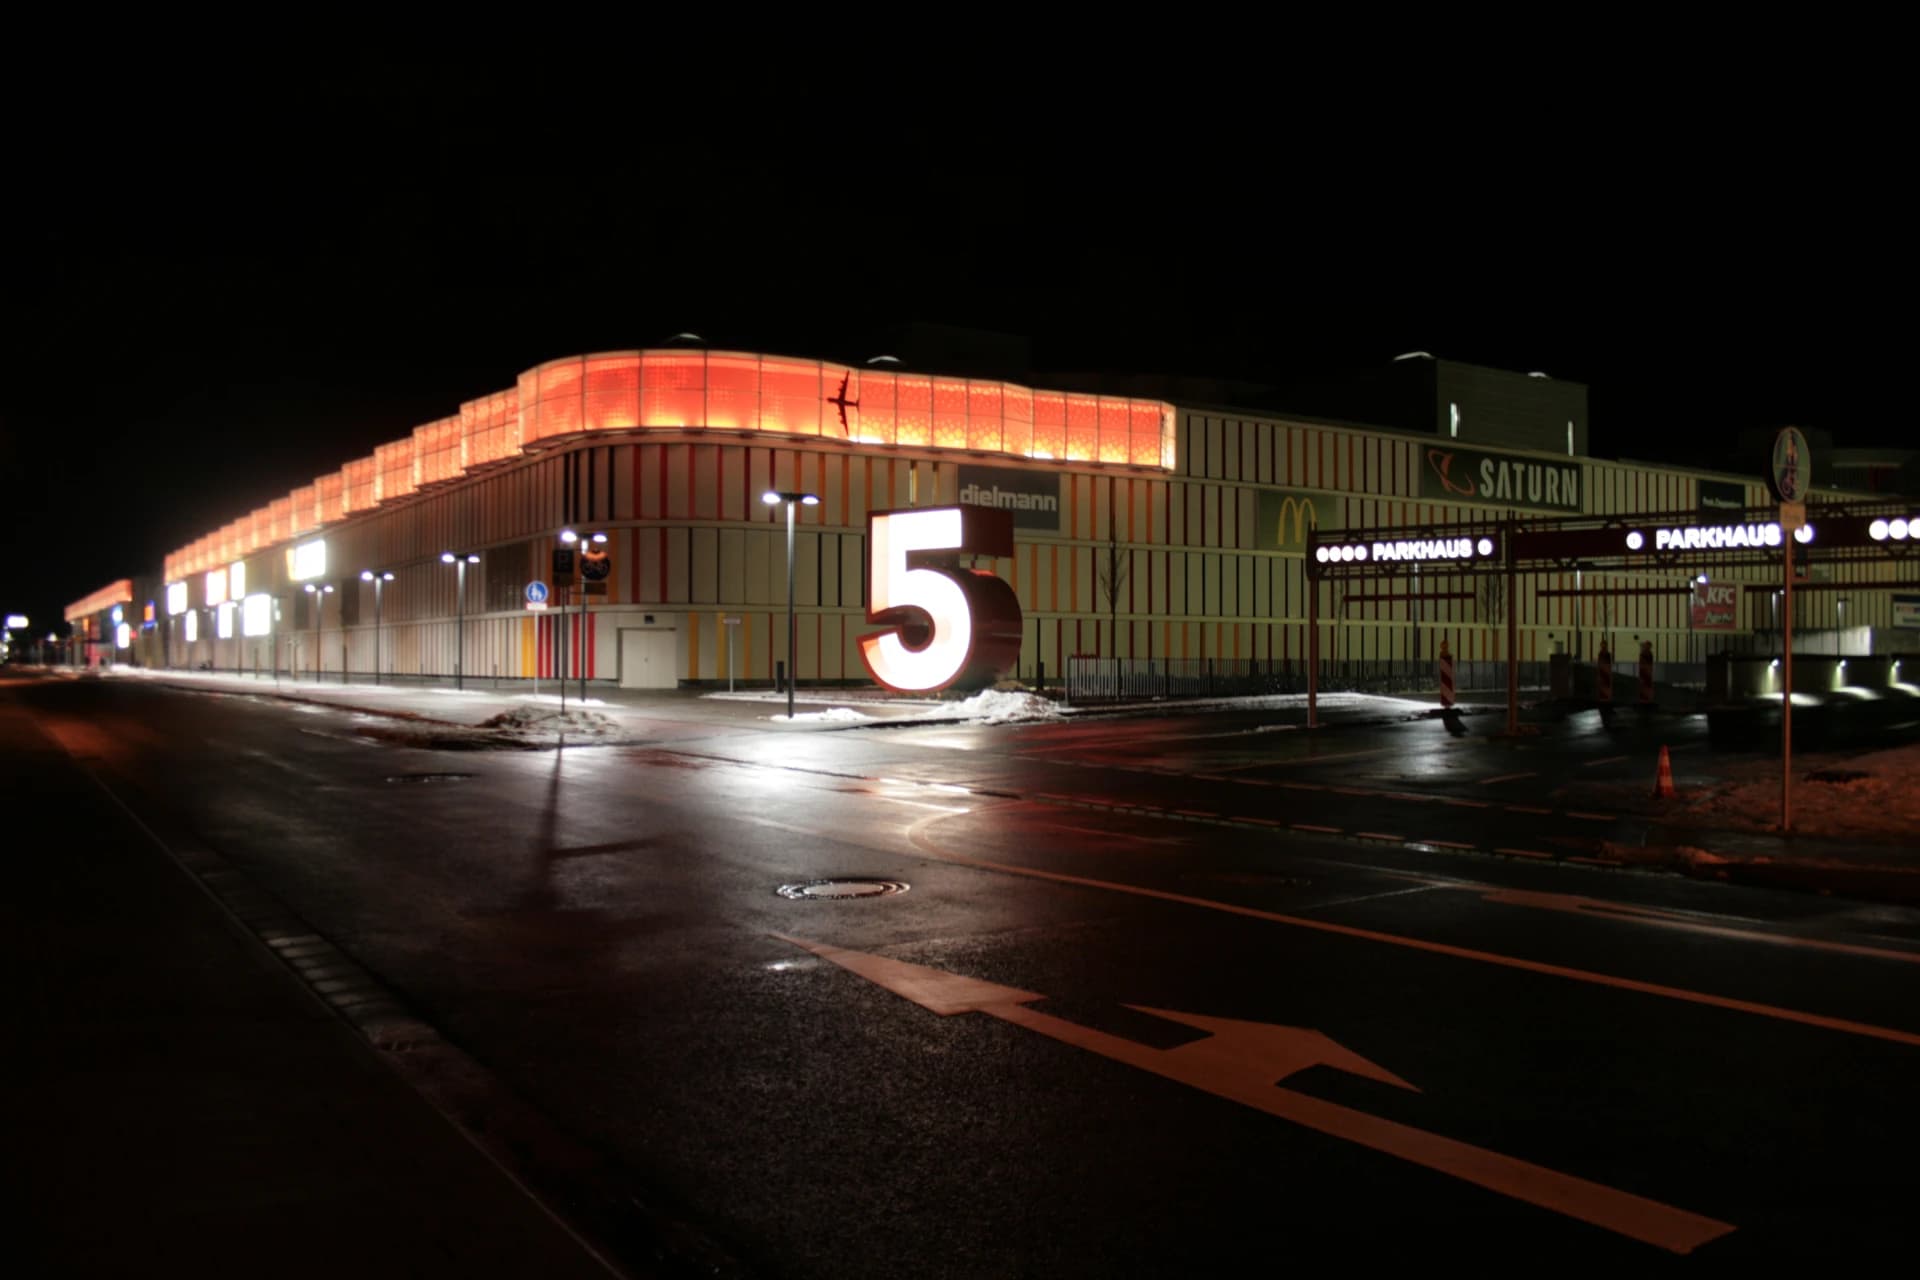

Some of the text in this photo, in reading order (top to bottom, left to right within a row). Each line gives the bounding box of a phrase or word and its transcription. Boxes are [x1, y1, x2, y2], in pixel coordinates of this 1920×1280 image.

[1479, 457, 1578, 507] SATURN
[959, 484, 1057, 512] dielmann
[1372, 538, 1473, 562] PARKHAUS
[1655, 523, 1782, 550] PARKHAUS
[856, 505, 974, 692] 5
[1706, 586, 1736, 605] KFC
